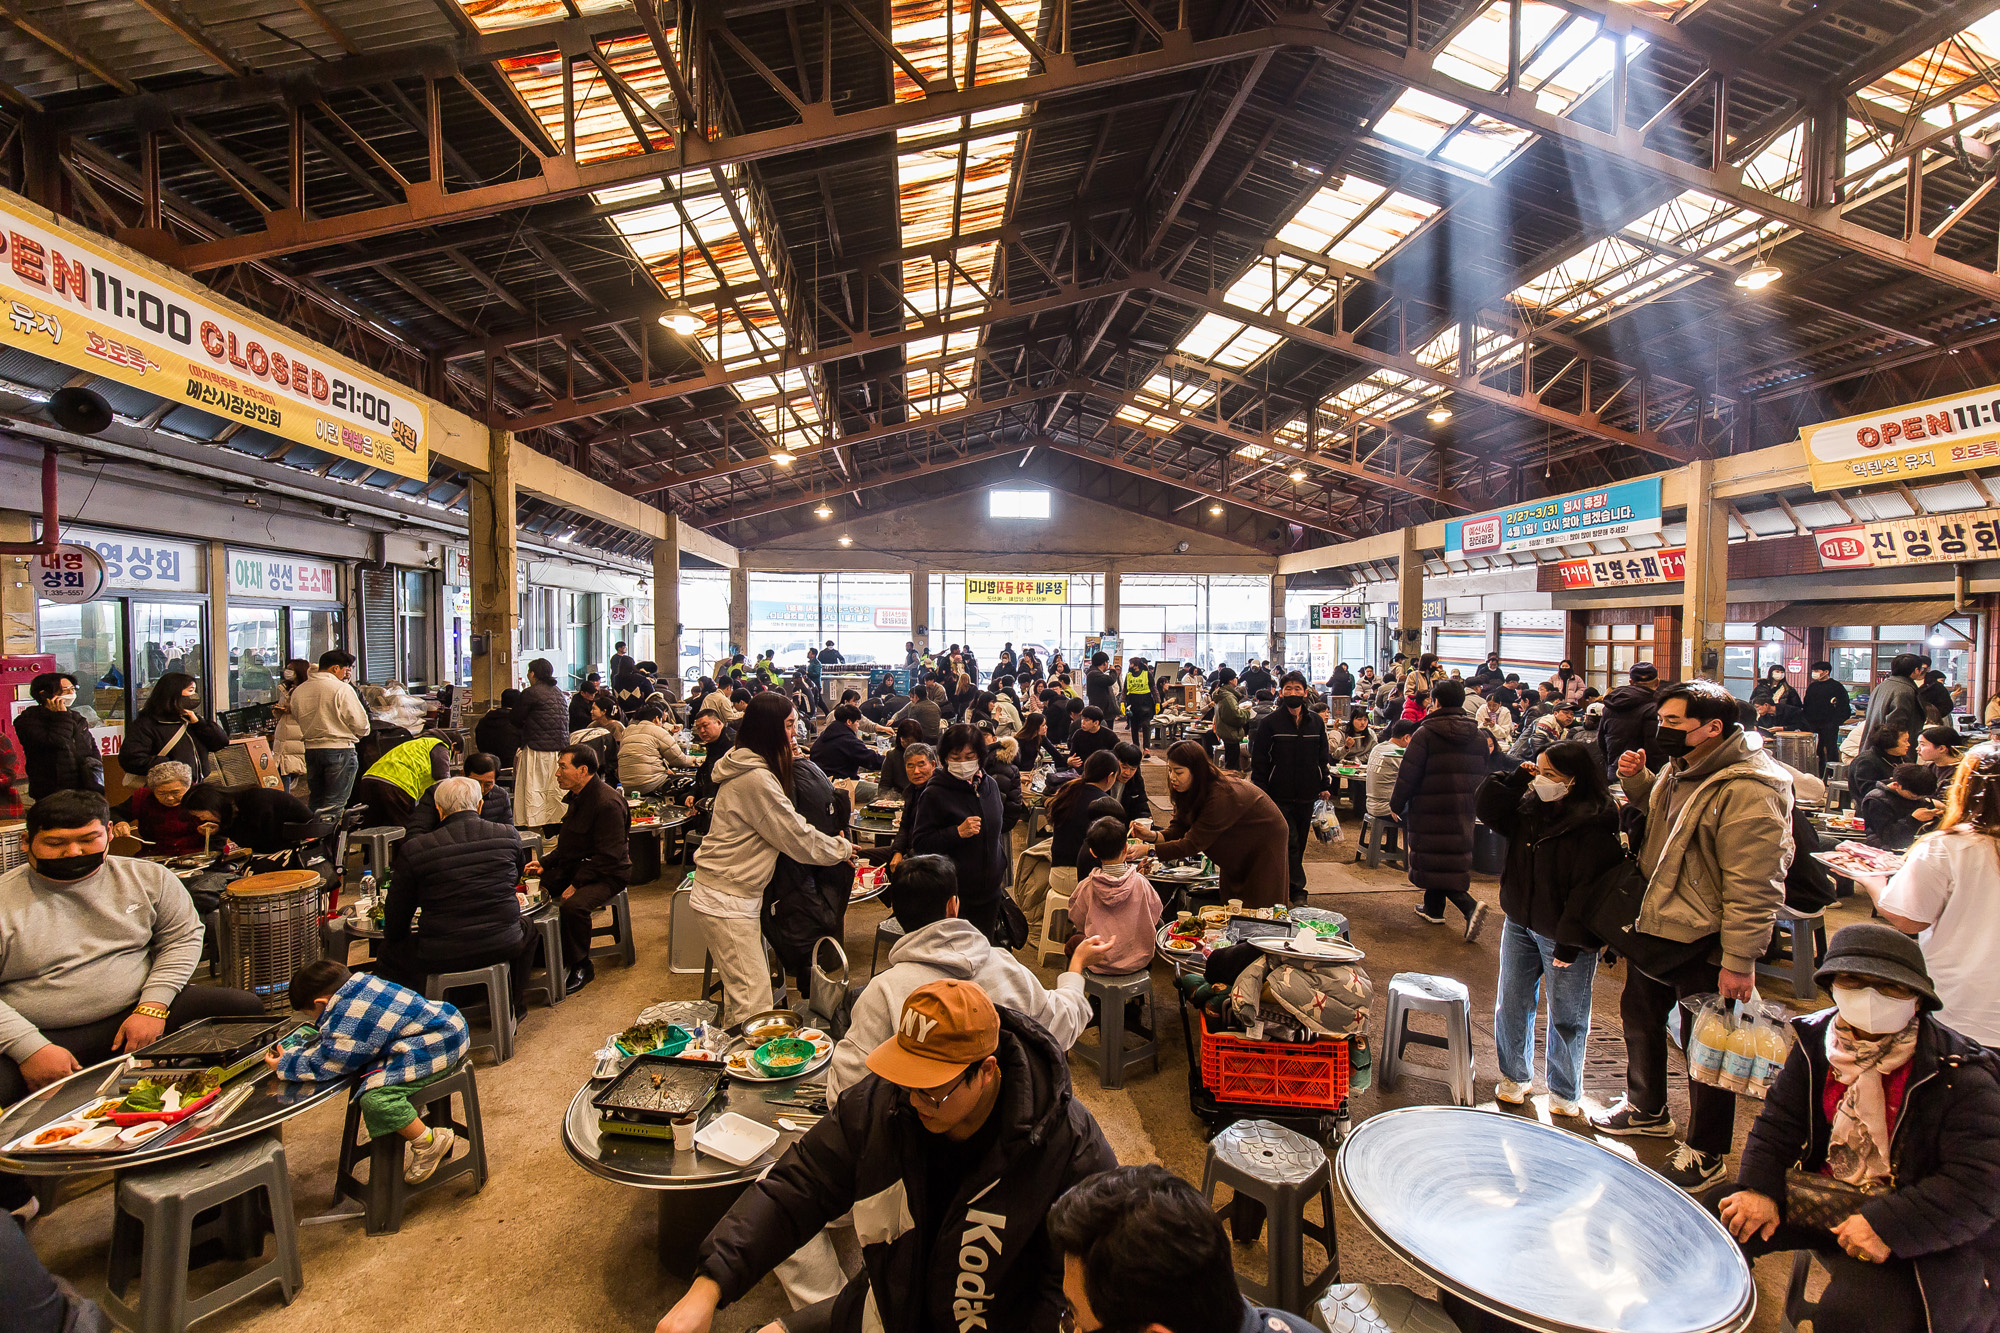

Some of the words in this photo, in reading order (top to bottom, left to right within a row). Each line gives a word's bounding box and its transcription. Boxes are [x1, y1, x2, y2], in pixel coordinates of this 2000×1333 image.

[92, 267, 191, 346] 11:00
[200, 320, 330, 401] CLOSED
[332, 378, 390, 427] 21:00
[9, 300, 63, 345] 유지
[315, 418, 339, 446] 이런
[341, 425, 373, 458] 먹방은
[374, 439, 395, 465] 처음
[242, 385, 276, 406] 20:30)
[186, 378, 281, 428] 예산시장상인회
[391, 416, 417, 453] 맛집
[1856, 411, 1953, 448] OPEN
[1852, 457, 1899, 477] 먹텐션
[1904, 450, 1935, 471] 유지
[1506, 503, 1558, 524] 2/27~3/31
[1562, 496, 1582, 515] 임시
[1583, 492, 1608, 511] 휴장!
[1506, 524, 1521, 538] 4월
[1522, 521, 1538, 535] 1일!
[1542, 518, 1560, 533] 다시
[1561, 514, 1580, 530] 찾아
[1582, 505, 1635, 526] 뵙겠습니다.
[1824, 540, 1859, 557] 미원
[1870, 519, 2000, 560] 진영상회
[41, 553, 83, 570] 대영
[235, 559, 263, 589] 야채
[268, 563, 293, 591] 생선
[298, 566, 332, 594] 도소매
[1560, 564, 1590, 582] 다시다
[1592, 556, 1660, 582] 진영슈퍼
[1660, 555, 1685, 575] 다시
[41, 571, 85, 588] 상회
[44, 589, 84, 597] T.335-5557
[900, 1007, 938, 1043] NY
